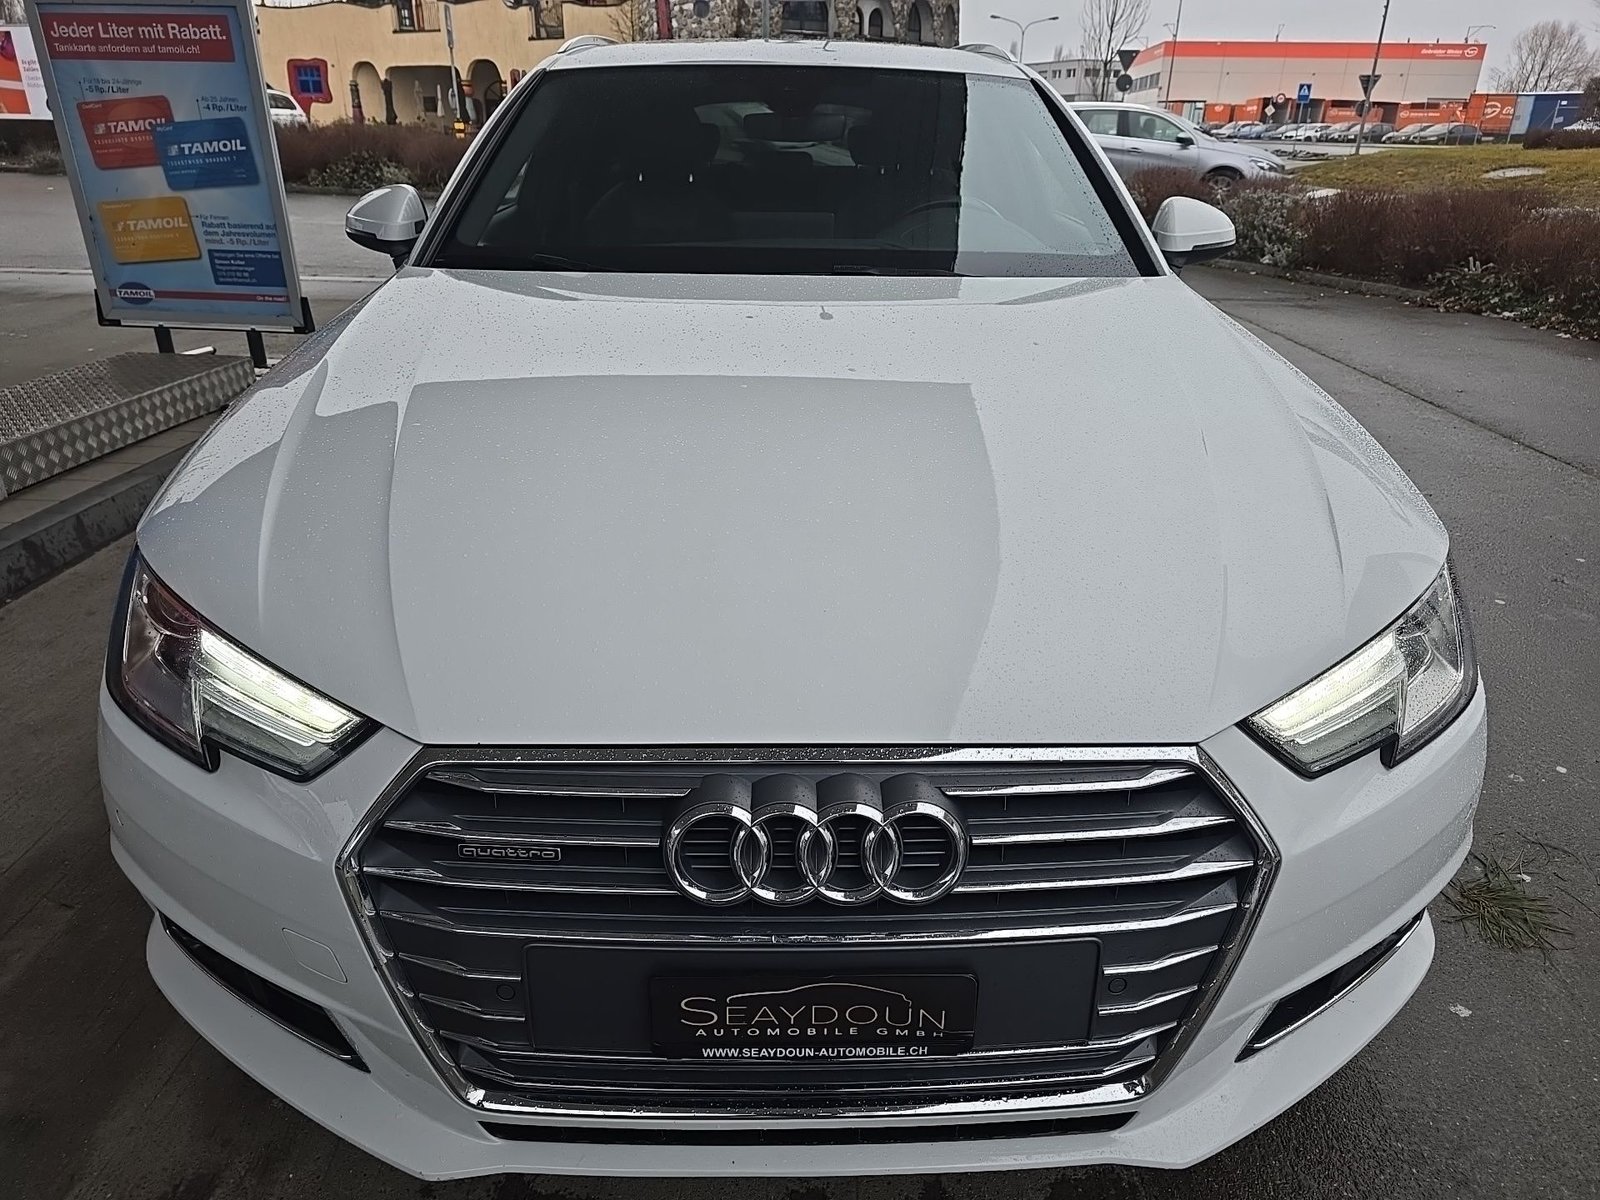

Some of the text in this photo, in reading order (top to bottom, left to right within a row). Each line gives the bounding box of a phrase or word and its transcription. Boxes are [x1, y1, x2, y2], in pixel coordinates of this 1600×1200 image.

[51, 21, 227, 40] Jeder Liter mit Rabatt.
[54, 43, 201, 54] Tankkarte anfordern auf tamoil.ch!
[85, 85, 94, 93] -5
[180, 139, 247, 155] TAMOIL
[127, 217, 188, 231] TAMOIL
[201, 221, 226, 229] Rabatt
[227, 222, 263, 230] basierend
[203, 229, 276, 238] dem Jahresvolumen
[463, 847, 555, 858] quattro
[680, 996, 946, 1030] SEAYDOUN
[695, 1027, 944, 1037] AUTOMOBILE GMBH
[702, 1045, 929, 1058] WWW.SEAYDOUN-AUTOMOBILE.CH
